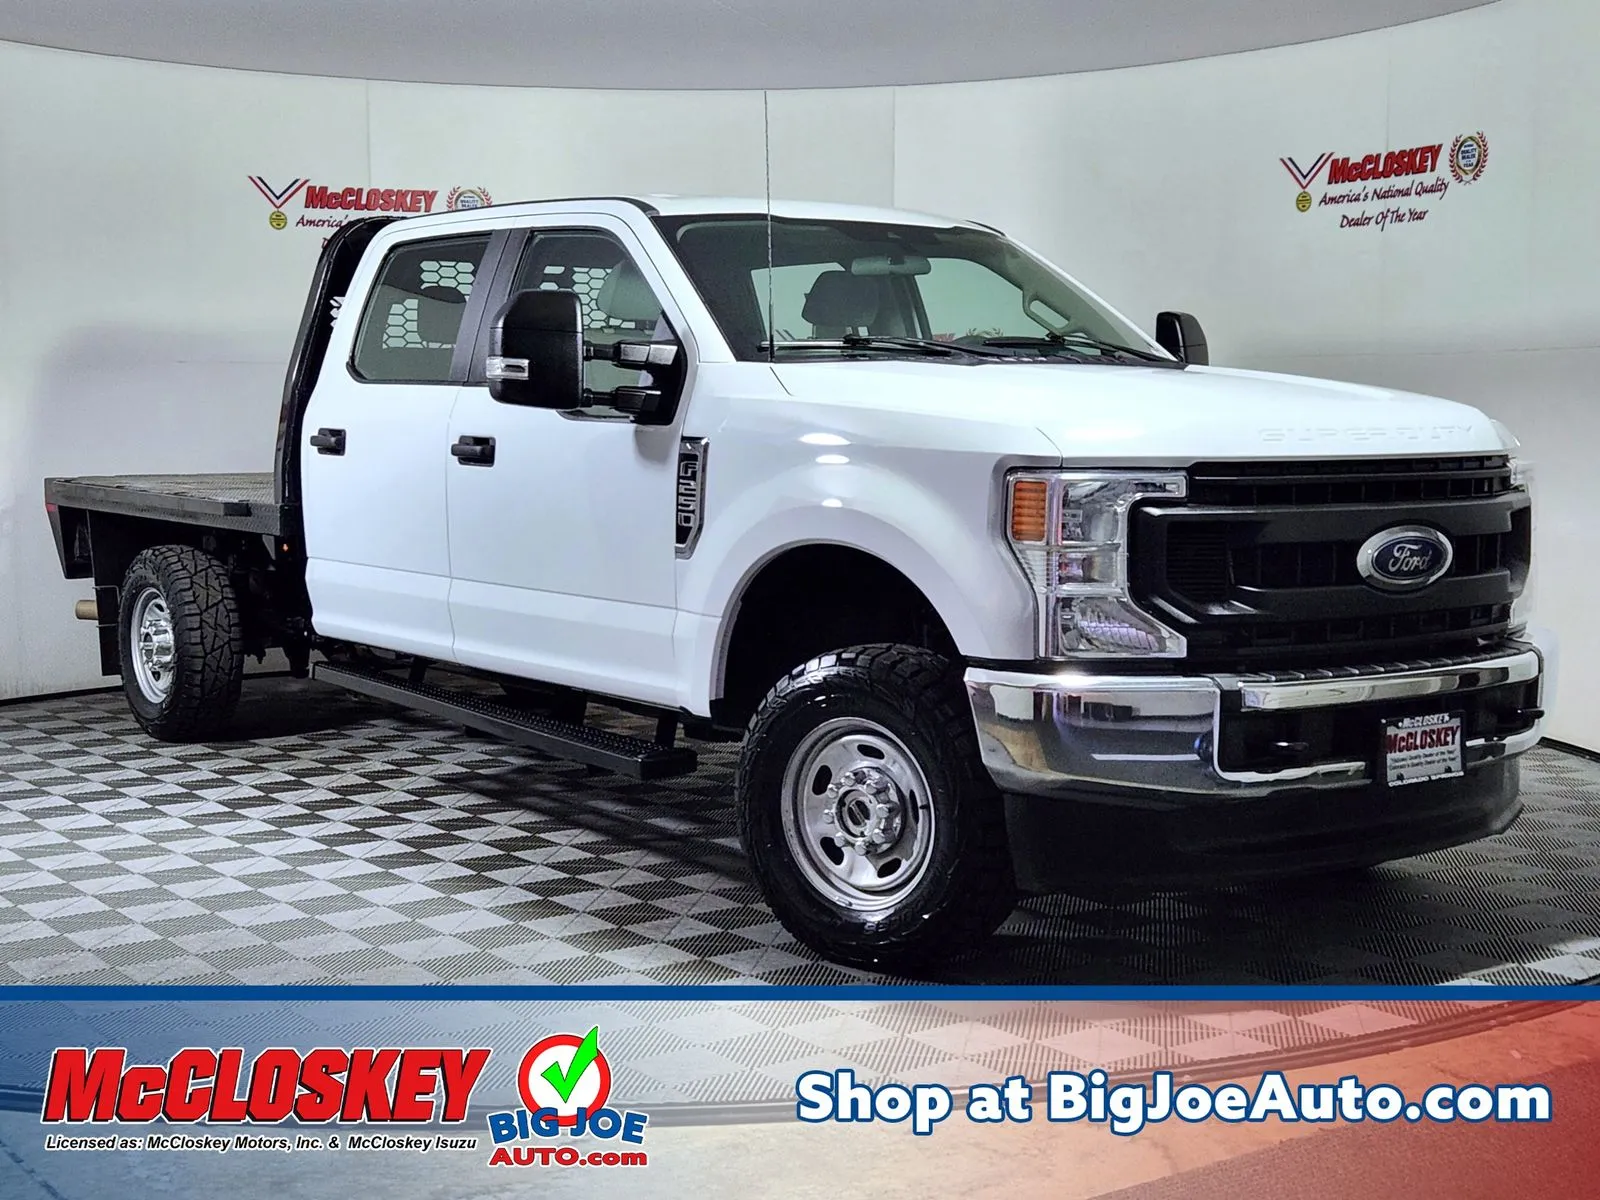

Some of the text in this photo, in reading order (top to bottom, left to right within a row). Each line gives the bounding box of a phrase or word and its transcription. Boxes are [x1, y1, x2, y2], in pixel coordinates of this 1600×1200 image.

[1327, 143, 1444, 185] McCLOSKEY
[304, 185, 439, 213] McCLOSKEY
[1318, 185, 1369, 207] America's
[1371, 181, 1413, 202] National
[1415, 176, 1450, 200] Quality
[296, 214, 349, 228] America'
[1339, 206, 1429, 232] Dealer Of The Year
[1388, 543, 1432, 573] Ford
[1386, 726, 1460, 754] McCLOSKEY
